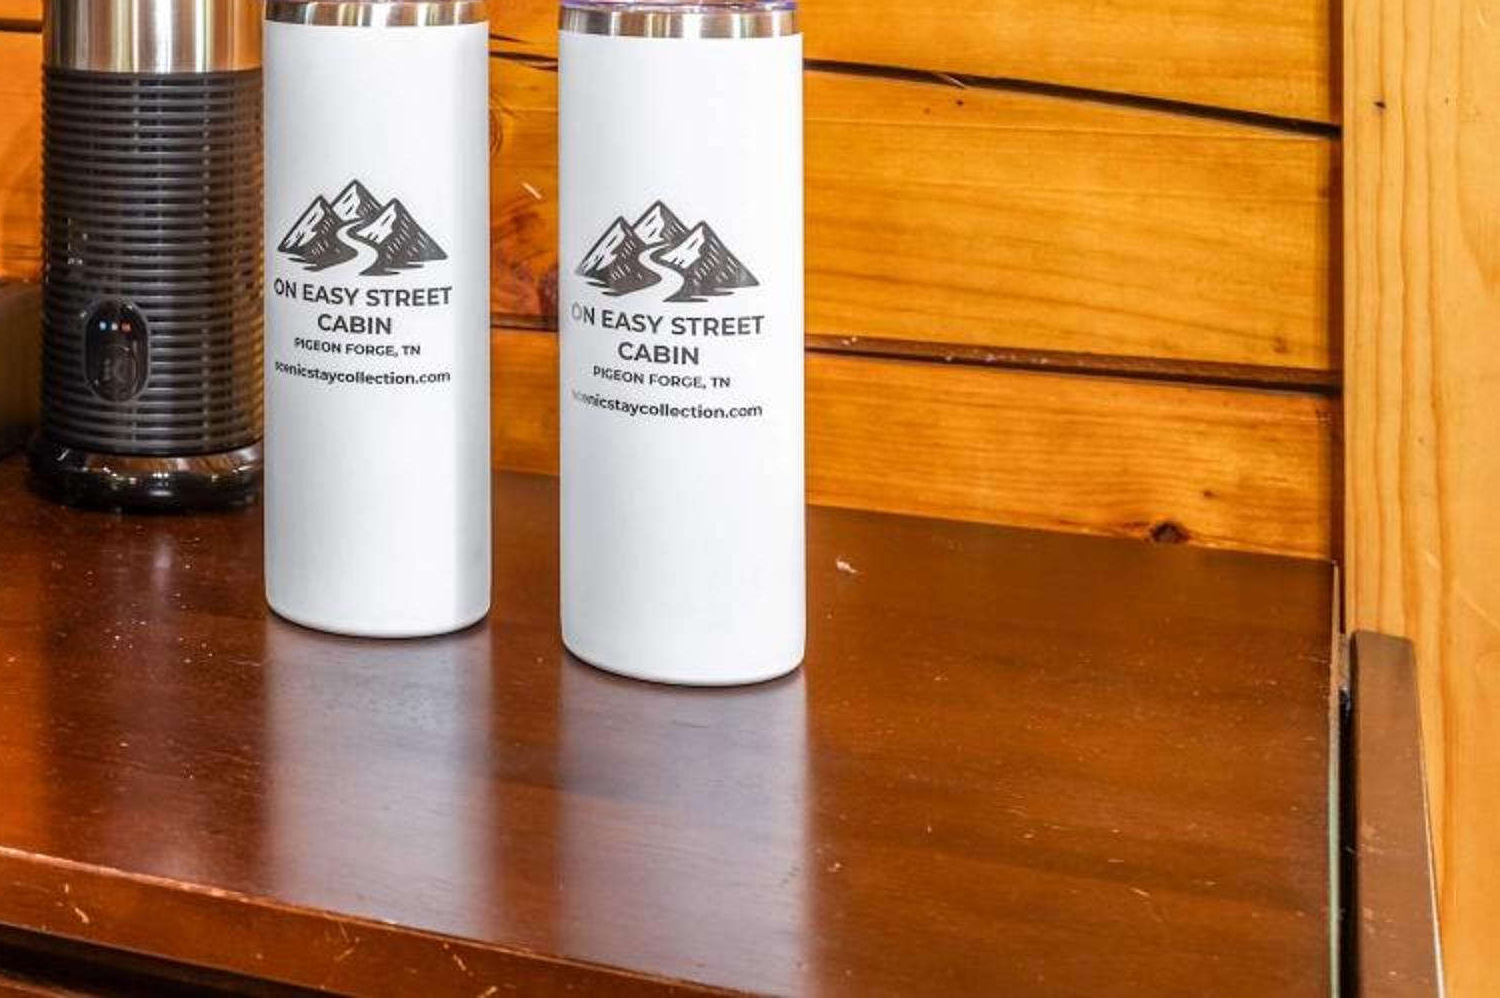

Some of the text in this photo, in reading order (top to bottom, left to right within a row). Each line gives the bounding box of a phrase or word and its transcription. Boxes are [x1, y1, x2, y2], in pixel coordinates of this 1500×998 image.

[273, 277, 453, 308] ON EASY STREET
[317, 313, 393, 336] CABIN
[571, 301, 765, 337] ON EASY STREET
[294, 337, 421, 358] PIGEON FORGE, TN
[617, 341, 700, 365] CABIN
[593, 365, 731, 390] PIGEON FORGE, TN
